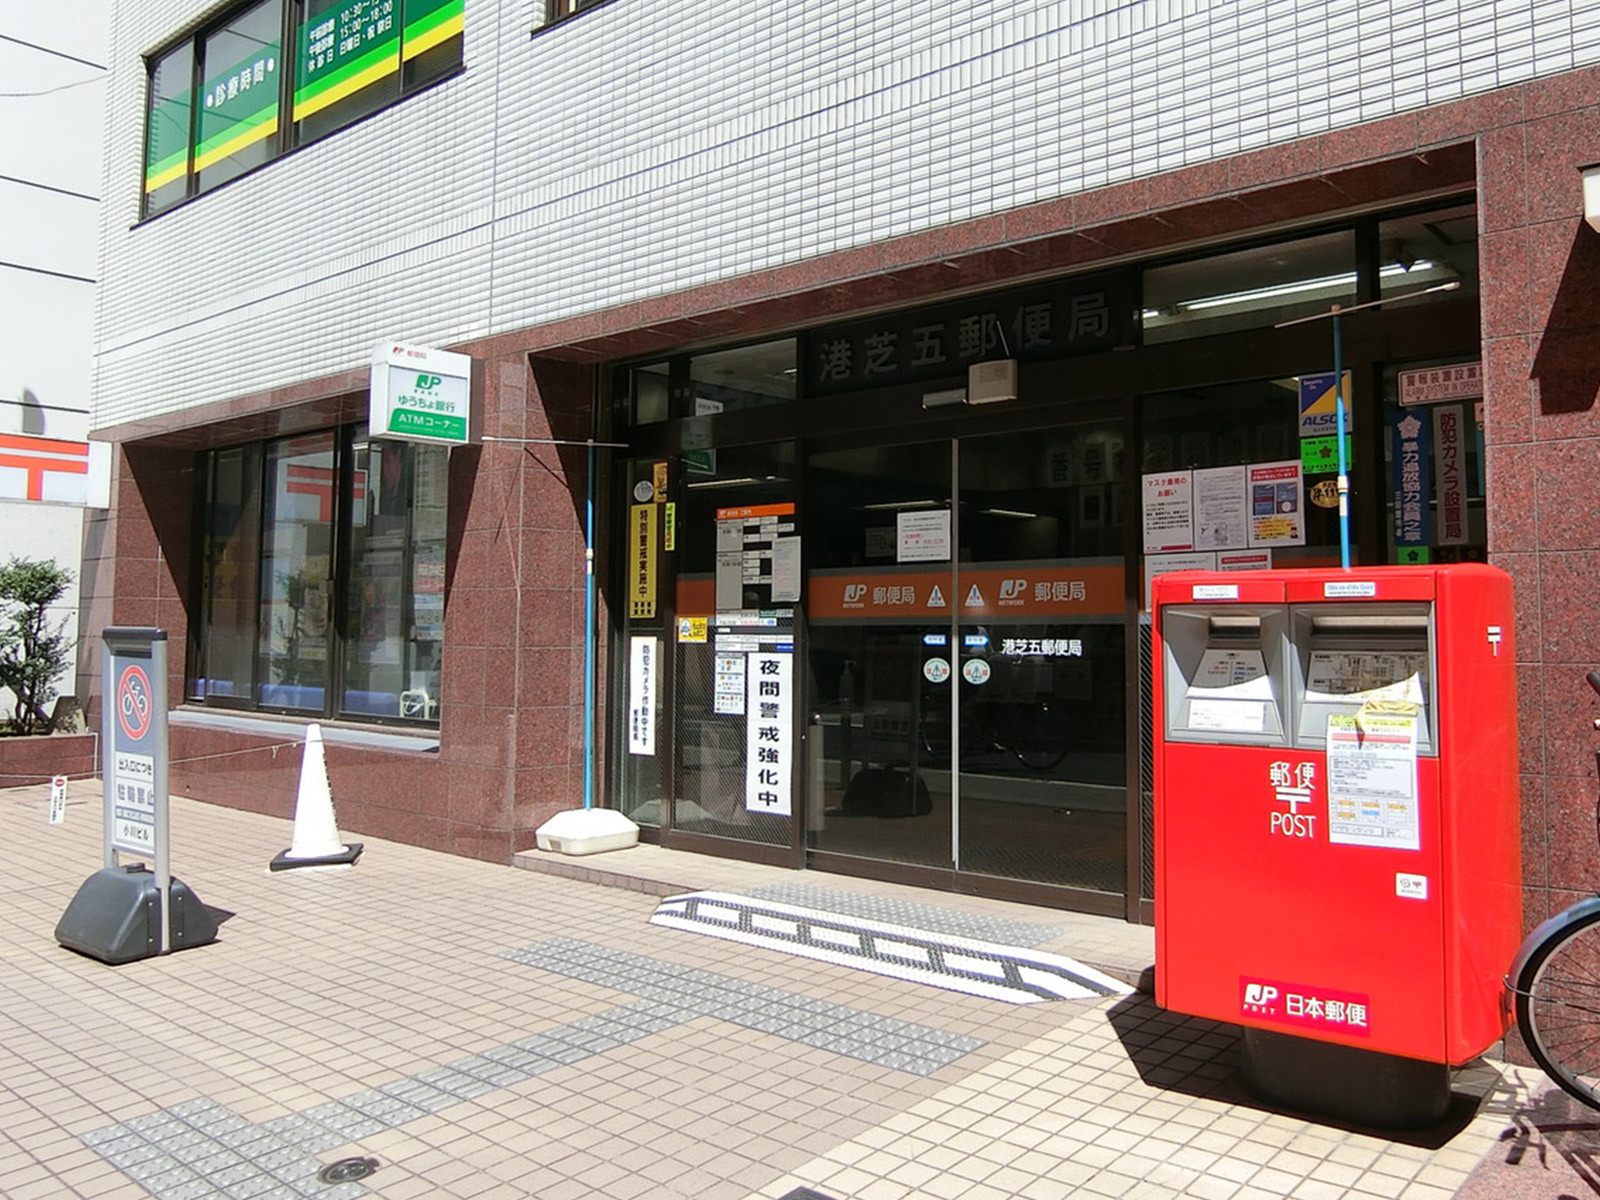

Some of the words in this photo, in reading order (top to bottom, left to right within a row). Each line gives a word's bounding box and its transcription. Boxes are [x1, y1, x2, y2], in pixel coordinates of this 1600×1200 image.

[819, 291, 1110, 383] 港芝五郵便局
[398, 395, 455, 413] ゆうちょ銀行
[398, 413, 460, 429] ATMコーナー
[1440, 412, 1462, 539] 防犯カメラ設置局
[872, 585, 915, 605] 郵便局
[1034, 581, 1086, 602] 郵便局
[1001, 638, 1083, 656] 港芝五郵便局
[758, 659, 781, 807] 夜間警戒強化中
[118, 759, 153, 776] 出入口につき
[1269, 760, 1316, 790] 郵便
[1270, 811, 1316, 839] POST
[1245, 983, 1278, 1006] JP
[1286, 993, 1368, 1027] 日本郵便
